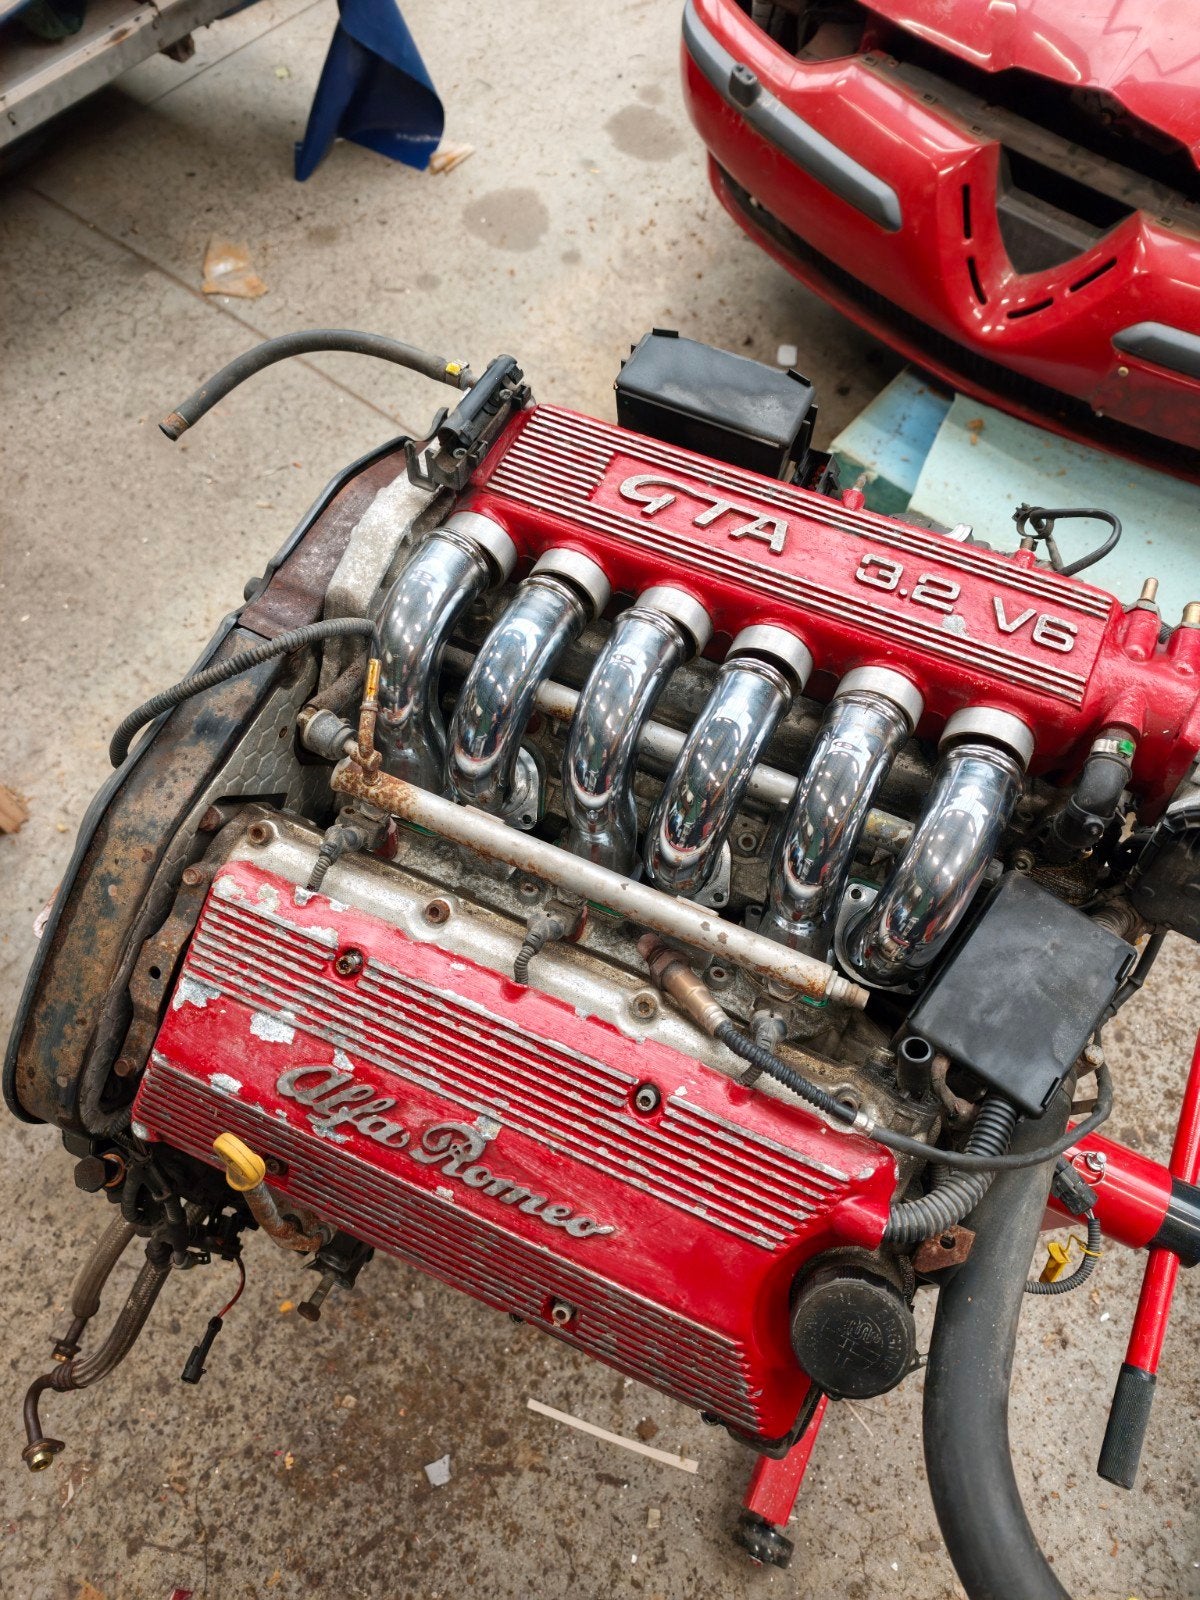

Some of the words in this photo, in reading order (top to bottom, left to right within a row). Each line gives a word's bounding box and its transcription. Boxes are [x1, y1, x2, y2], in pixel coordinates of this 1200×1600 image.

[618, 474, 789, 555] GTA
[853, 552, 962, 614] 3.2
[992, 596, 1079, 653] V6
[276, 1065, 411, 1149] Alfa
[409, 1121, 616, 1238] Romeo
